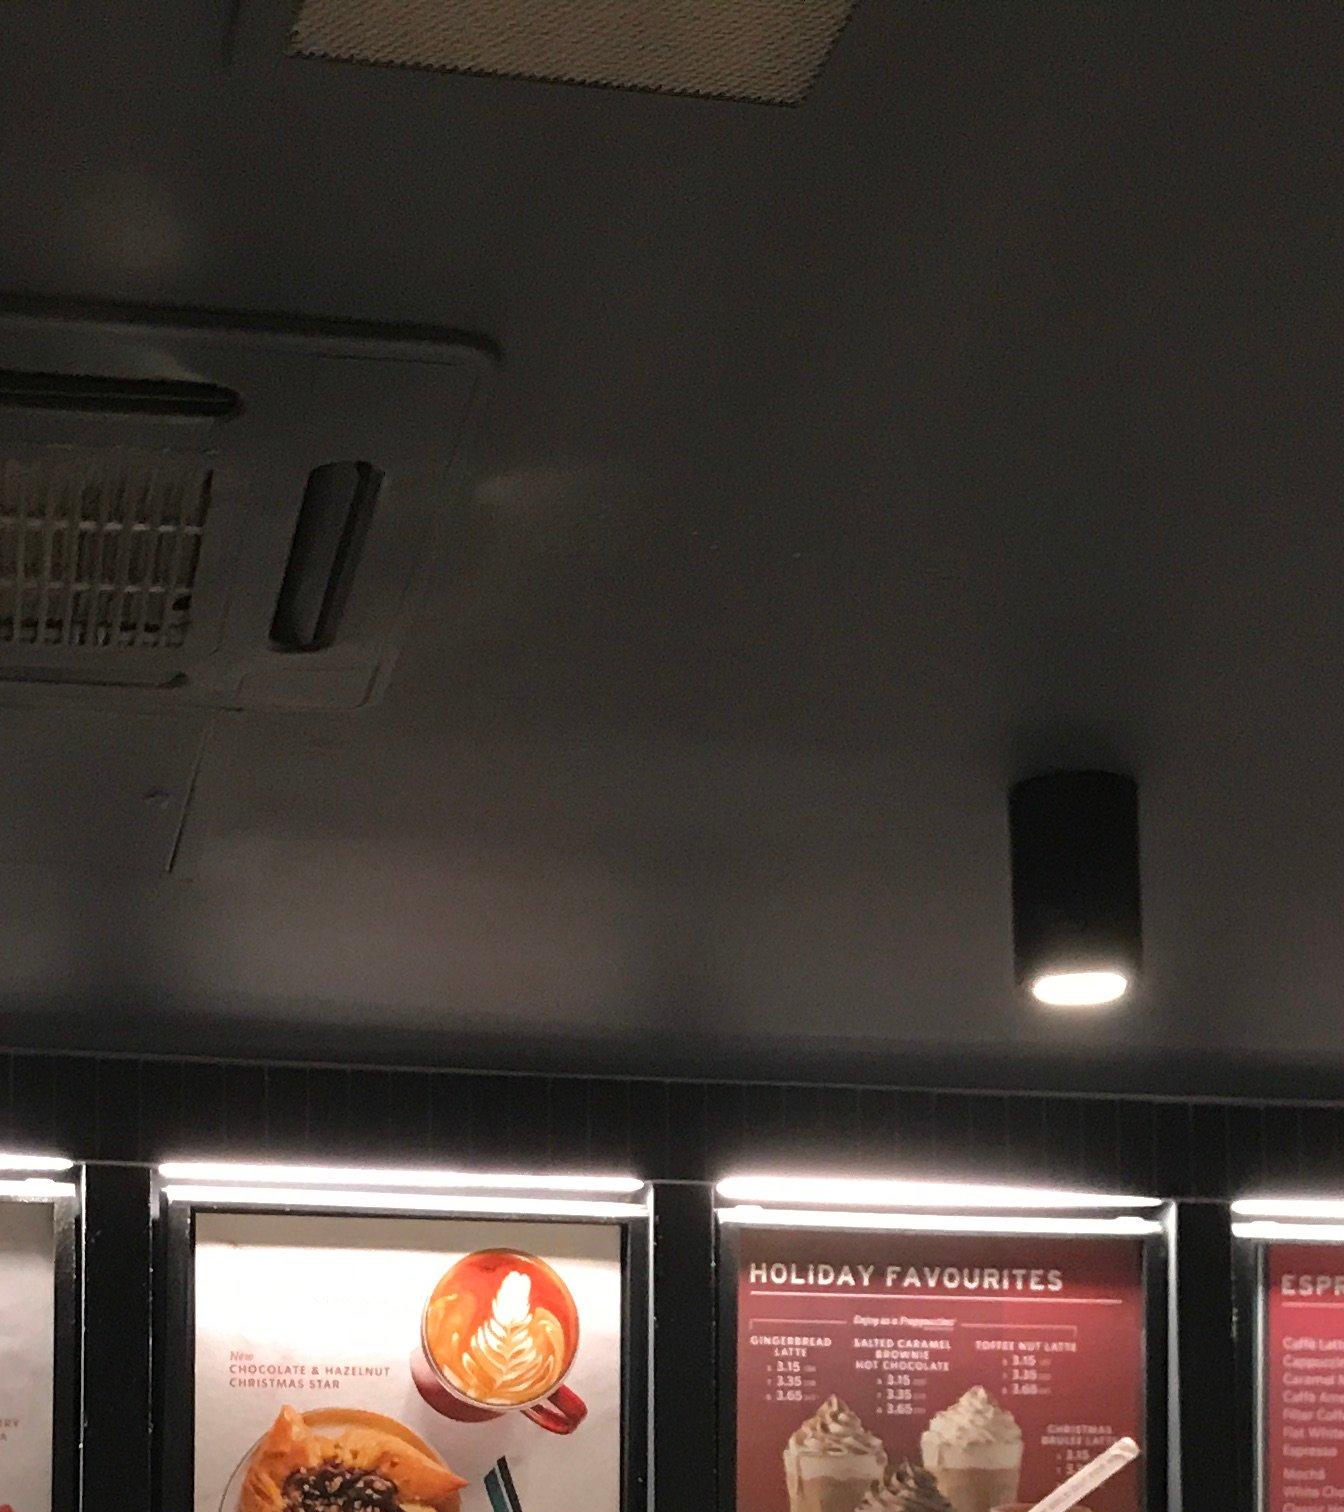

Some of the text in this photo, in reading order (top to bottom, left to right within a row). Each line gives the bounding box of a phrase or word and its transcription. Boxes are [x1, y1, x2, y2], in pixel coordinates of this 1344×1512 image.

[750, 1262, 1063, 1291] HOLIDAY FAVOURITES
[750, 1336, 832, 1346] GINGERBREAD
[853, 1338, 951, 1349] SALTED CARAMEL
[975, 1340, 1077, 1352] TOFFEE NUT LATTE
[229, 1351, 254, 1361] New
[774, 1348, 807, 1357] LATTE
[875, 1350, 929, 1360] BROWNIE
[229, 1364, 390, 1376] CHOCOLATE & HAZELNUT
[776, 1361, 800, 1373] 3.15
[855, 1361, 950, 1371] HOT CHOCOLATE
[229, 1378, 340, 1389] CHRISTMAS STAR
[776, 1375, 802, 1387] 3.35
[1283, 1372, 1334, 1386] Caramel
[776, 1390, 803, 1401] 3.65
[1046, 1424, 1112, 1434] CHRISTMAS
